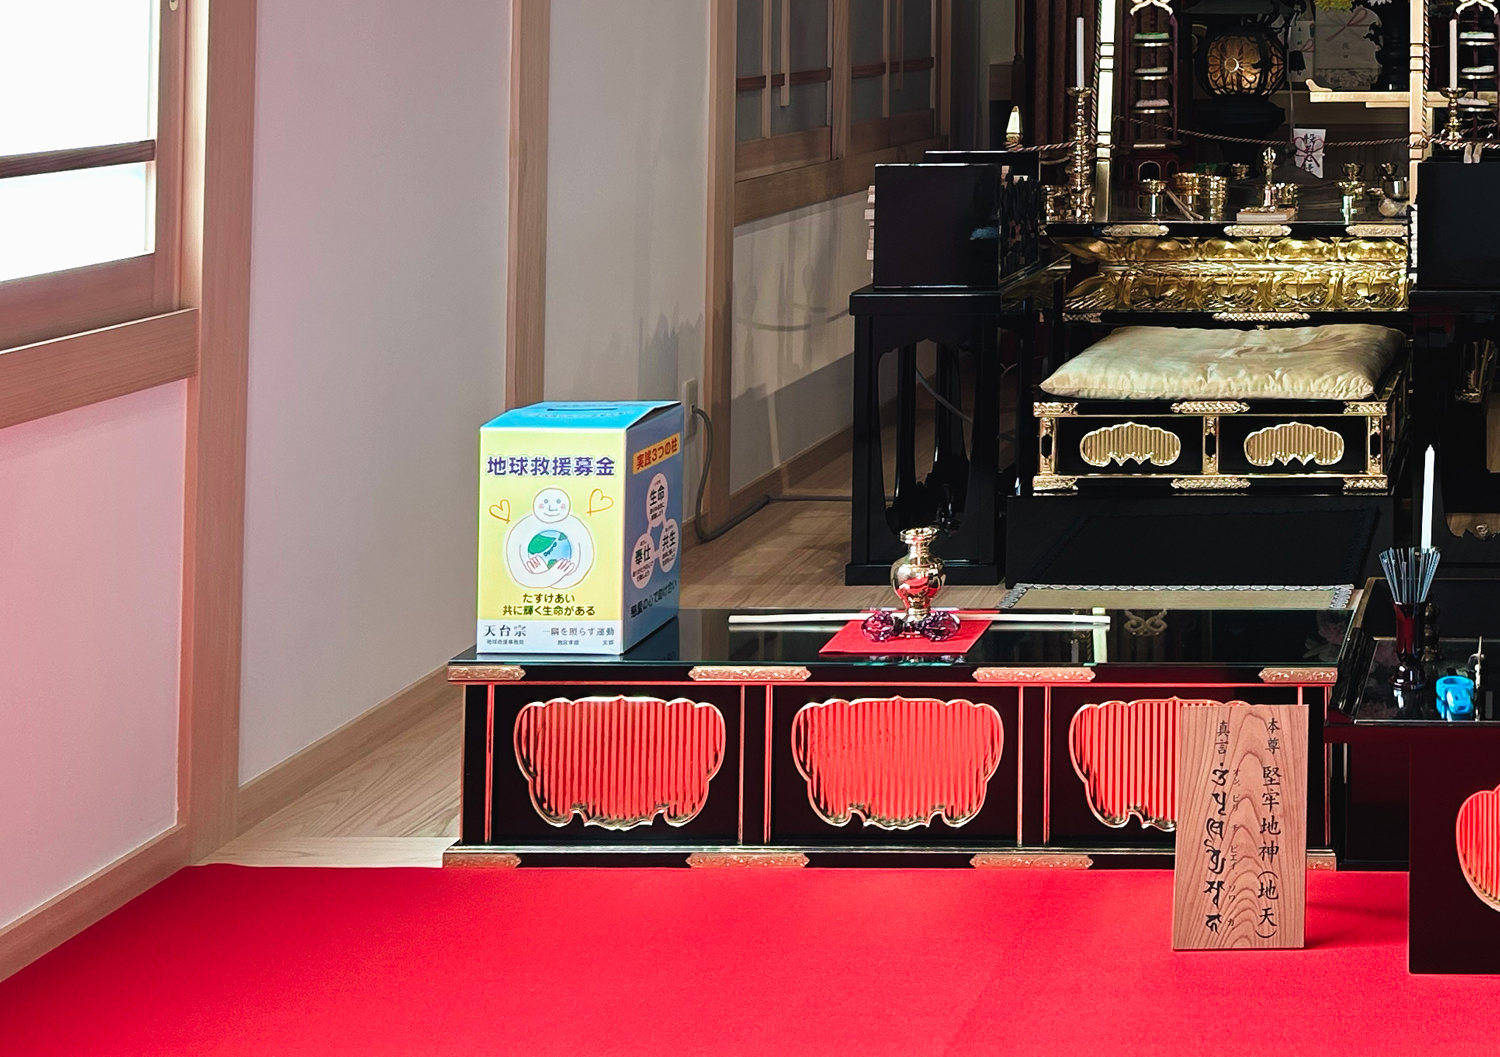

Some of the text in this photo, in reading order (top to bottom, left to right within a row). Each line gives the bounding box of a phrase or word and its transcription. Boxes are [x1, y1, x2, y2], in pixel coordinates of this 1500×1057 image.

[487, 456, 616, 477] 地球救援募金
[649, 485, 665, 506] 生命
[522, 593, 576, 604] たすけあい
[502, 605, 596, 616] 共に輝く生命がある
[484, 624, 527, 637] 天台宗
[1215, 720, 1230, 754] 真言
